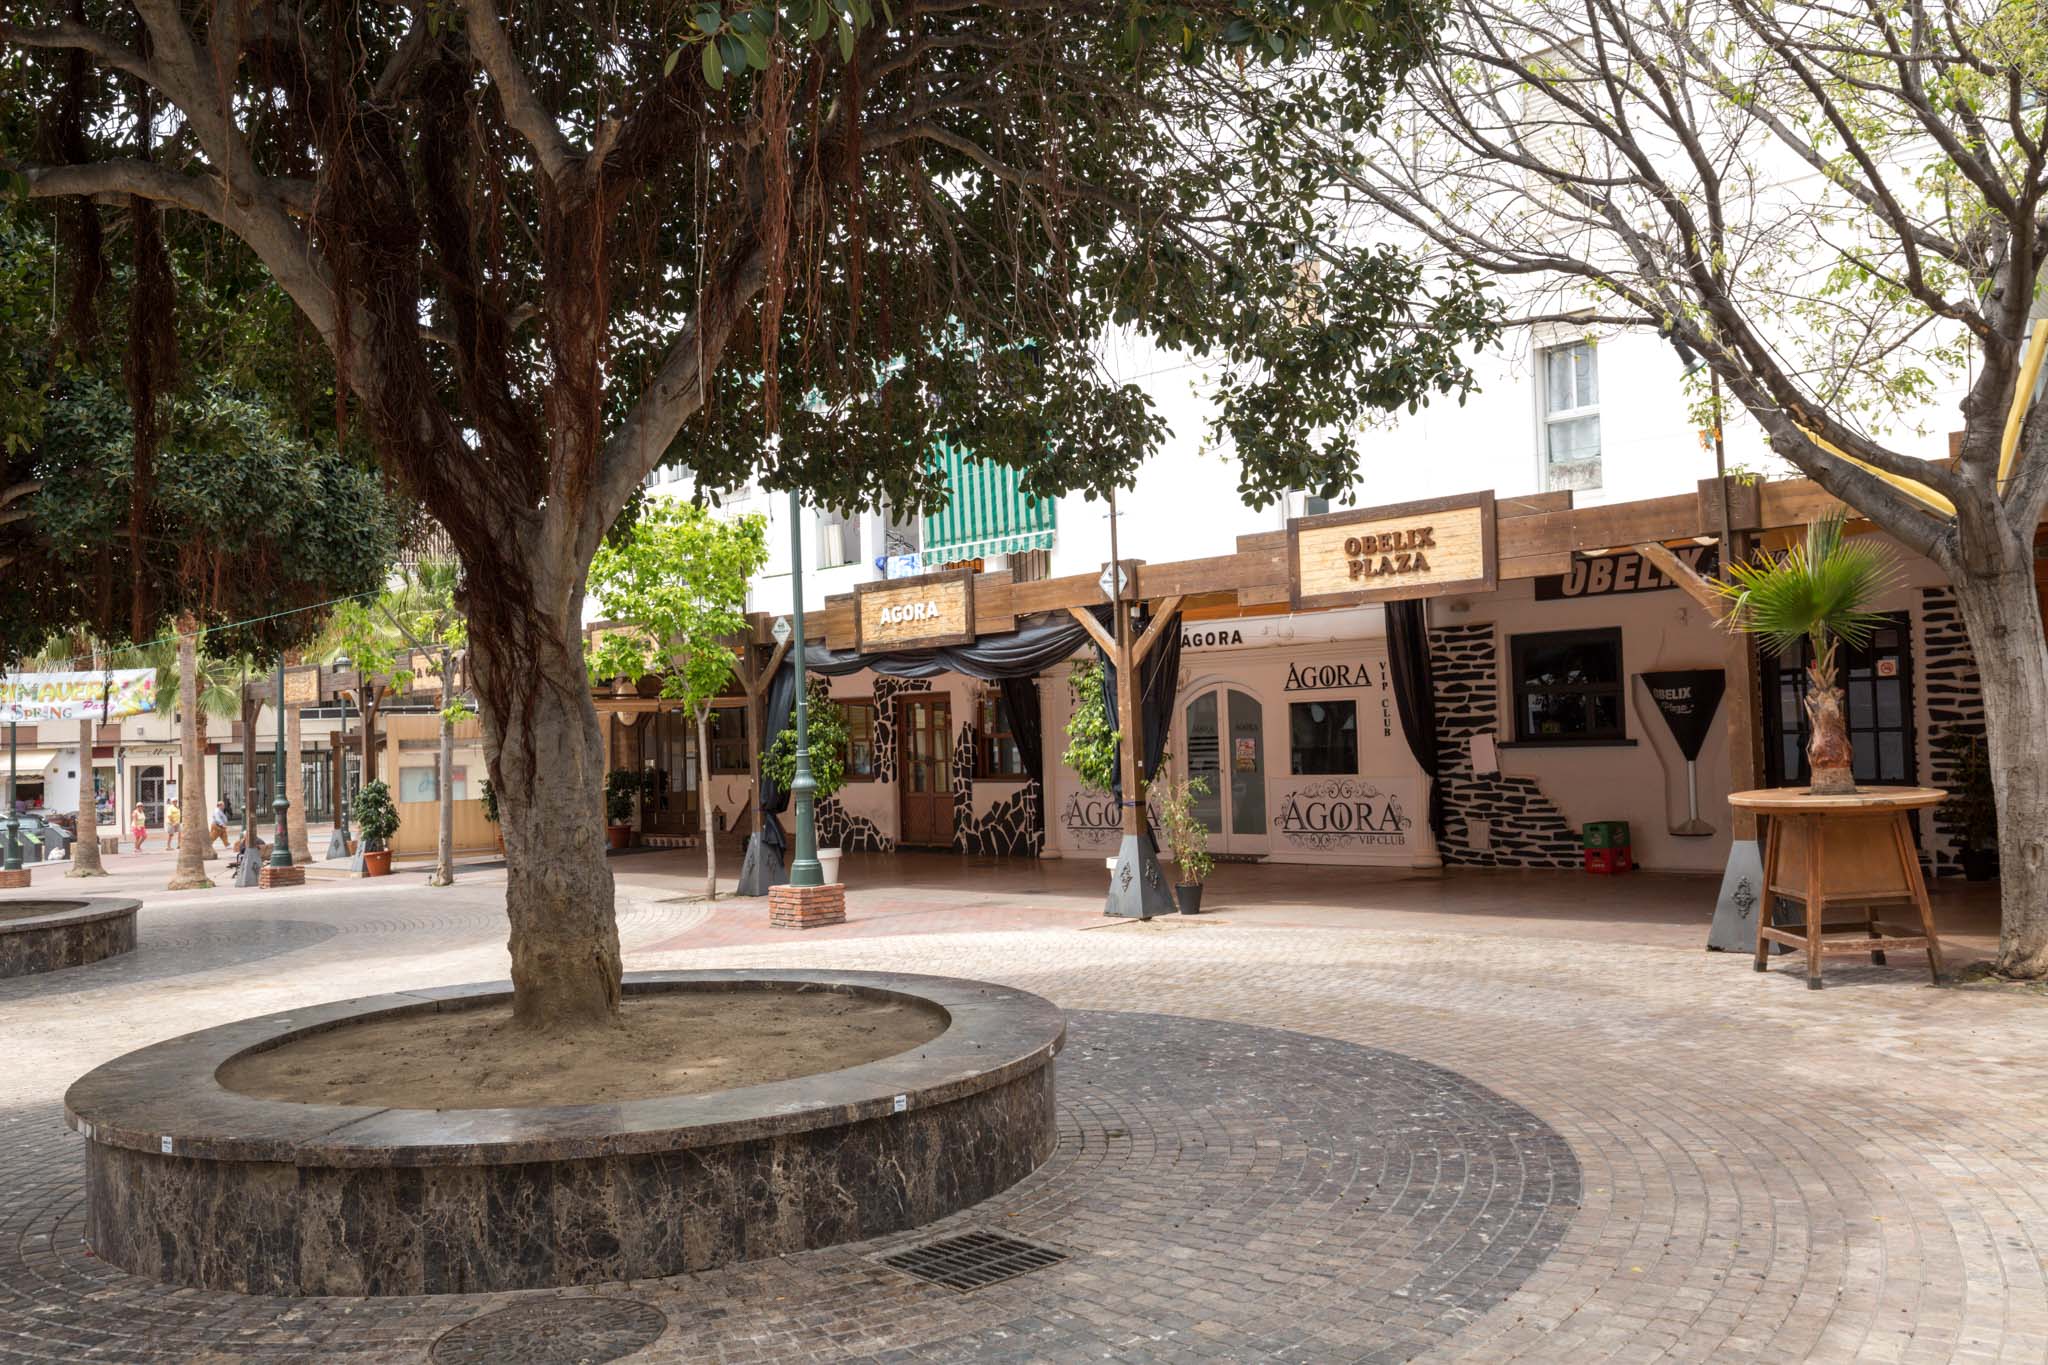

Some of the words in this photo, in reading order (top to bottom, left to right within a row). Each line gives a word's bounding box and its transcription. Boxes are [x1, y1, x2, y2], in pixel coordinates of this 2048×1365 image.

[1344, 526, 1436, 557] OBELIX
[1347, 551, 1431, 579] PLAZA
[880, 600, 940, 626] AGORA
[1285, 662, 1371, 690] ÁGORA
[1378, 661, 1389, 692] VIP
[1653, 687, 1692, 700] OBELIX
[1381, 698, 1391, 737] CLUB
[1067, 792, 1160, 828] ÁGOA
[1283, 791, 1403, 831] ÁGORA
[1360, 835, 1376, 845] VIP
[1377, 835, 1405, 846] CLUB
